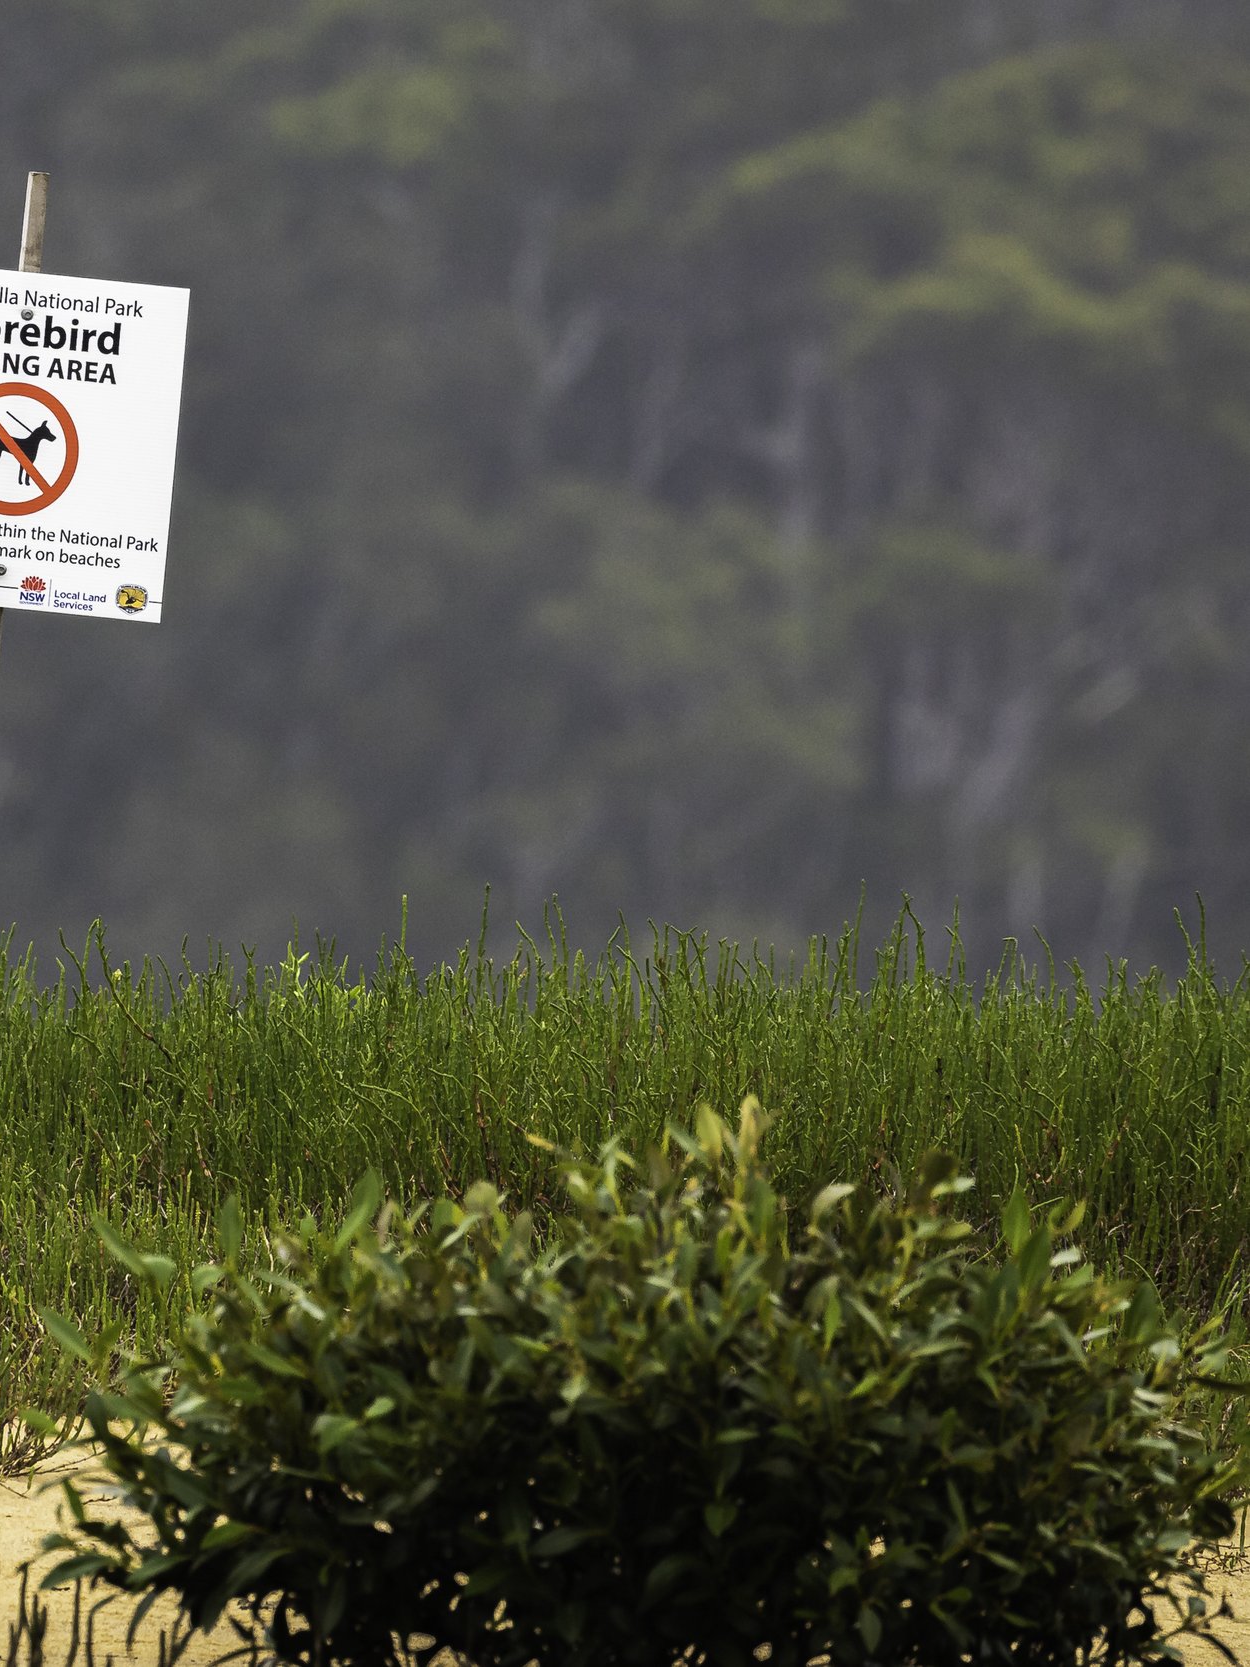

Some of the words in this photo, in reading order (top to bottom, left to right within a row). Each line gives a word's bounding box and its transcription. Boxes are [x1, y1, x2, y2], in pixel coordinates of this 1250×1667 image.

[24, 290, 99, 313] National
[105, 298, 143, 318] Park
[47, 358, 117, 385] AREA
[31, 526, 56, 542] the
[60, 529, 122, 549] National
[127, 537, 159, 553] Park
[35, 549, 54, 562] on
[59, 550, 120, 569] beaches
[20, 591, 45, 602] NSW
[53, 600, 93, 611] Services
[54, 590, 80, 600] Local
[82, 591, 107, 603] Land
